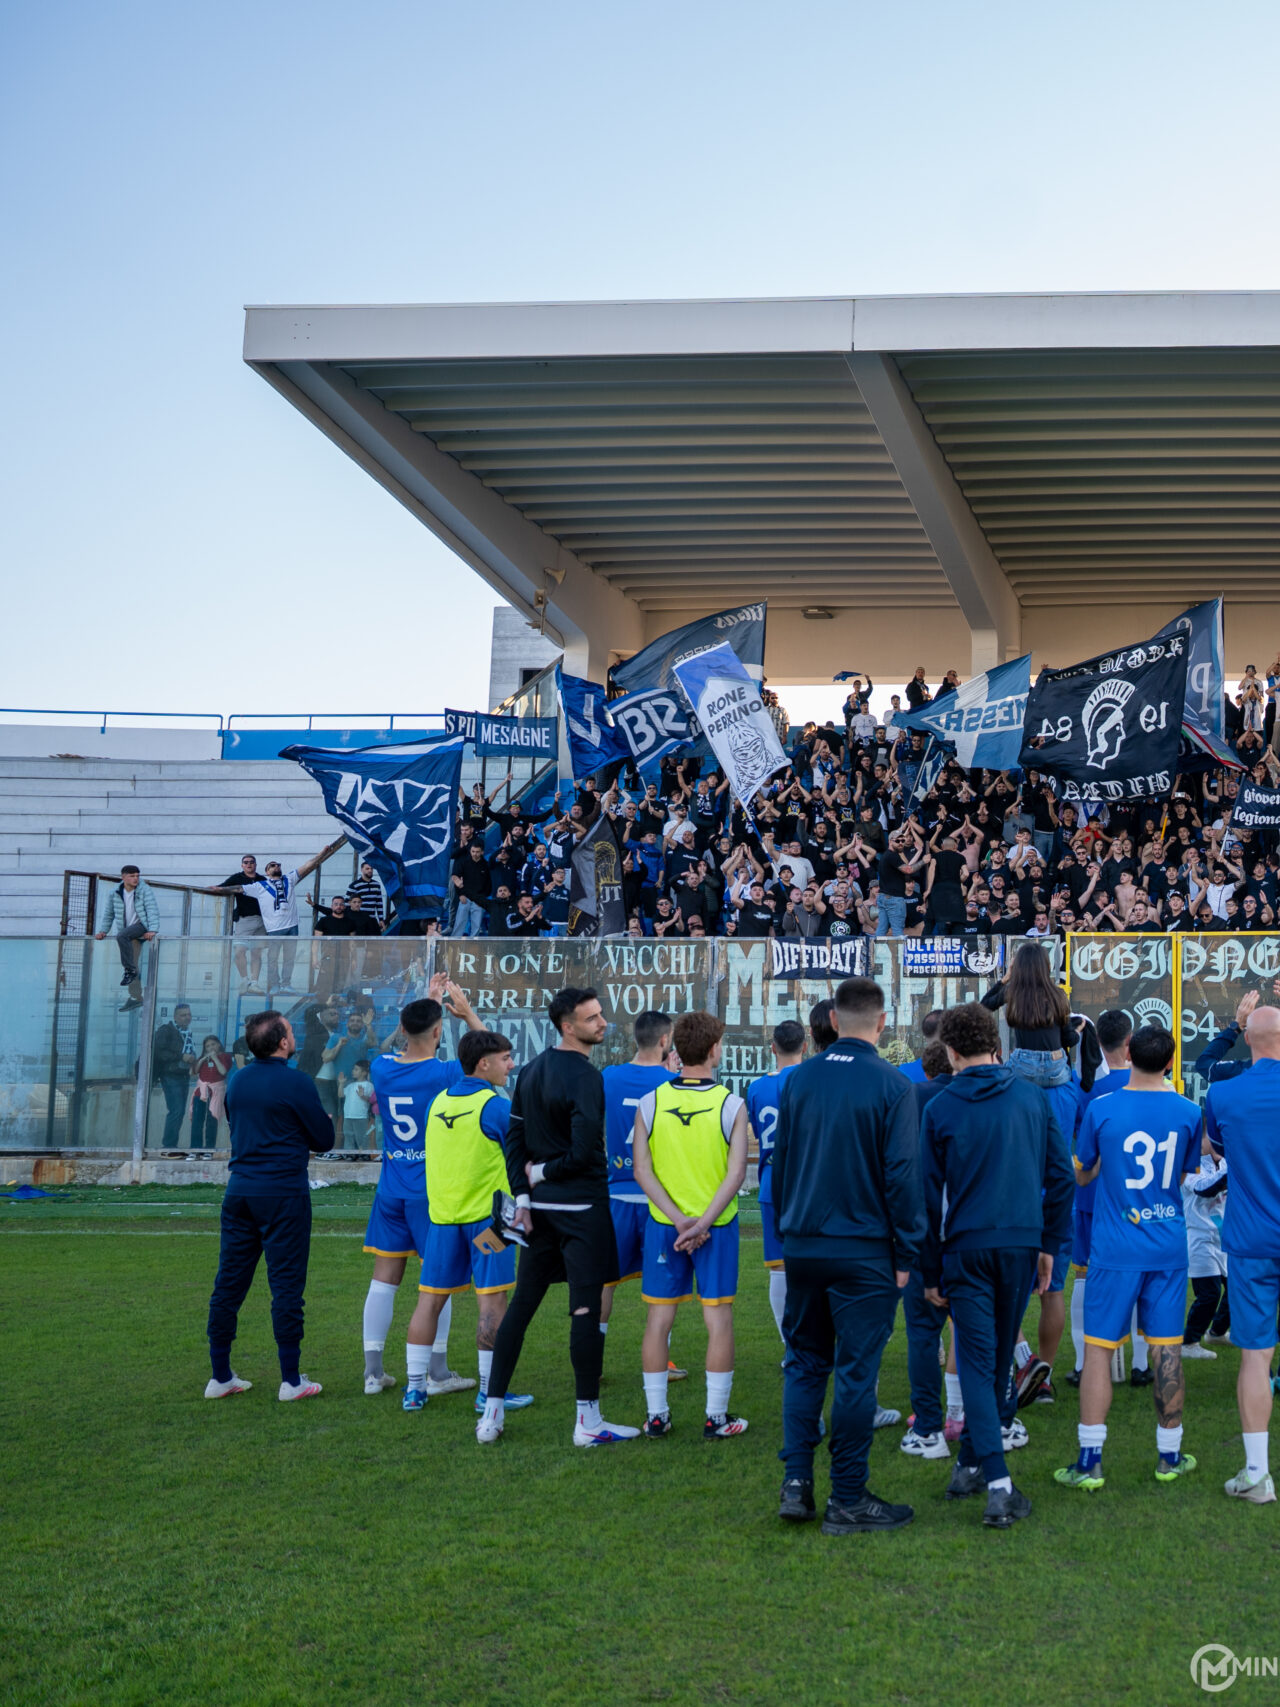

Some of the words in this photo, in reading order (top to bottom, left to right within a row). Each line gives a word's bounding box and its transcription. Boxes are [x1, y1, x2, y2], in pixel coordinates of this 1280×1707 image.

[481, 722, 551, 748] MESAGNE
[604, 944, 698, 976] VECCHI
[772, 938, 865, 977] DIFFIDATI
[907, 937, 961, 951] ULTRAS
[907, 953, 961, 963] PASSIONE
[458, 953, 565, 975] RIONE
[907, 965, 961, 974] PADERBORN
[607, 982, 695, 1015] VOLTI
[388, 1096, 418, 1142] 5
[758, 1105, 779, 1149] 2
[1123, 1130, 1178, 1190] 31
